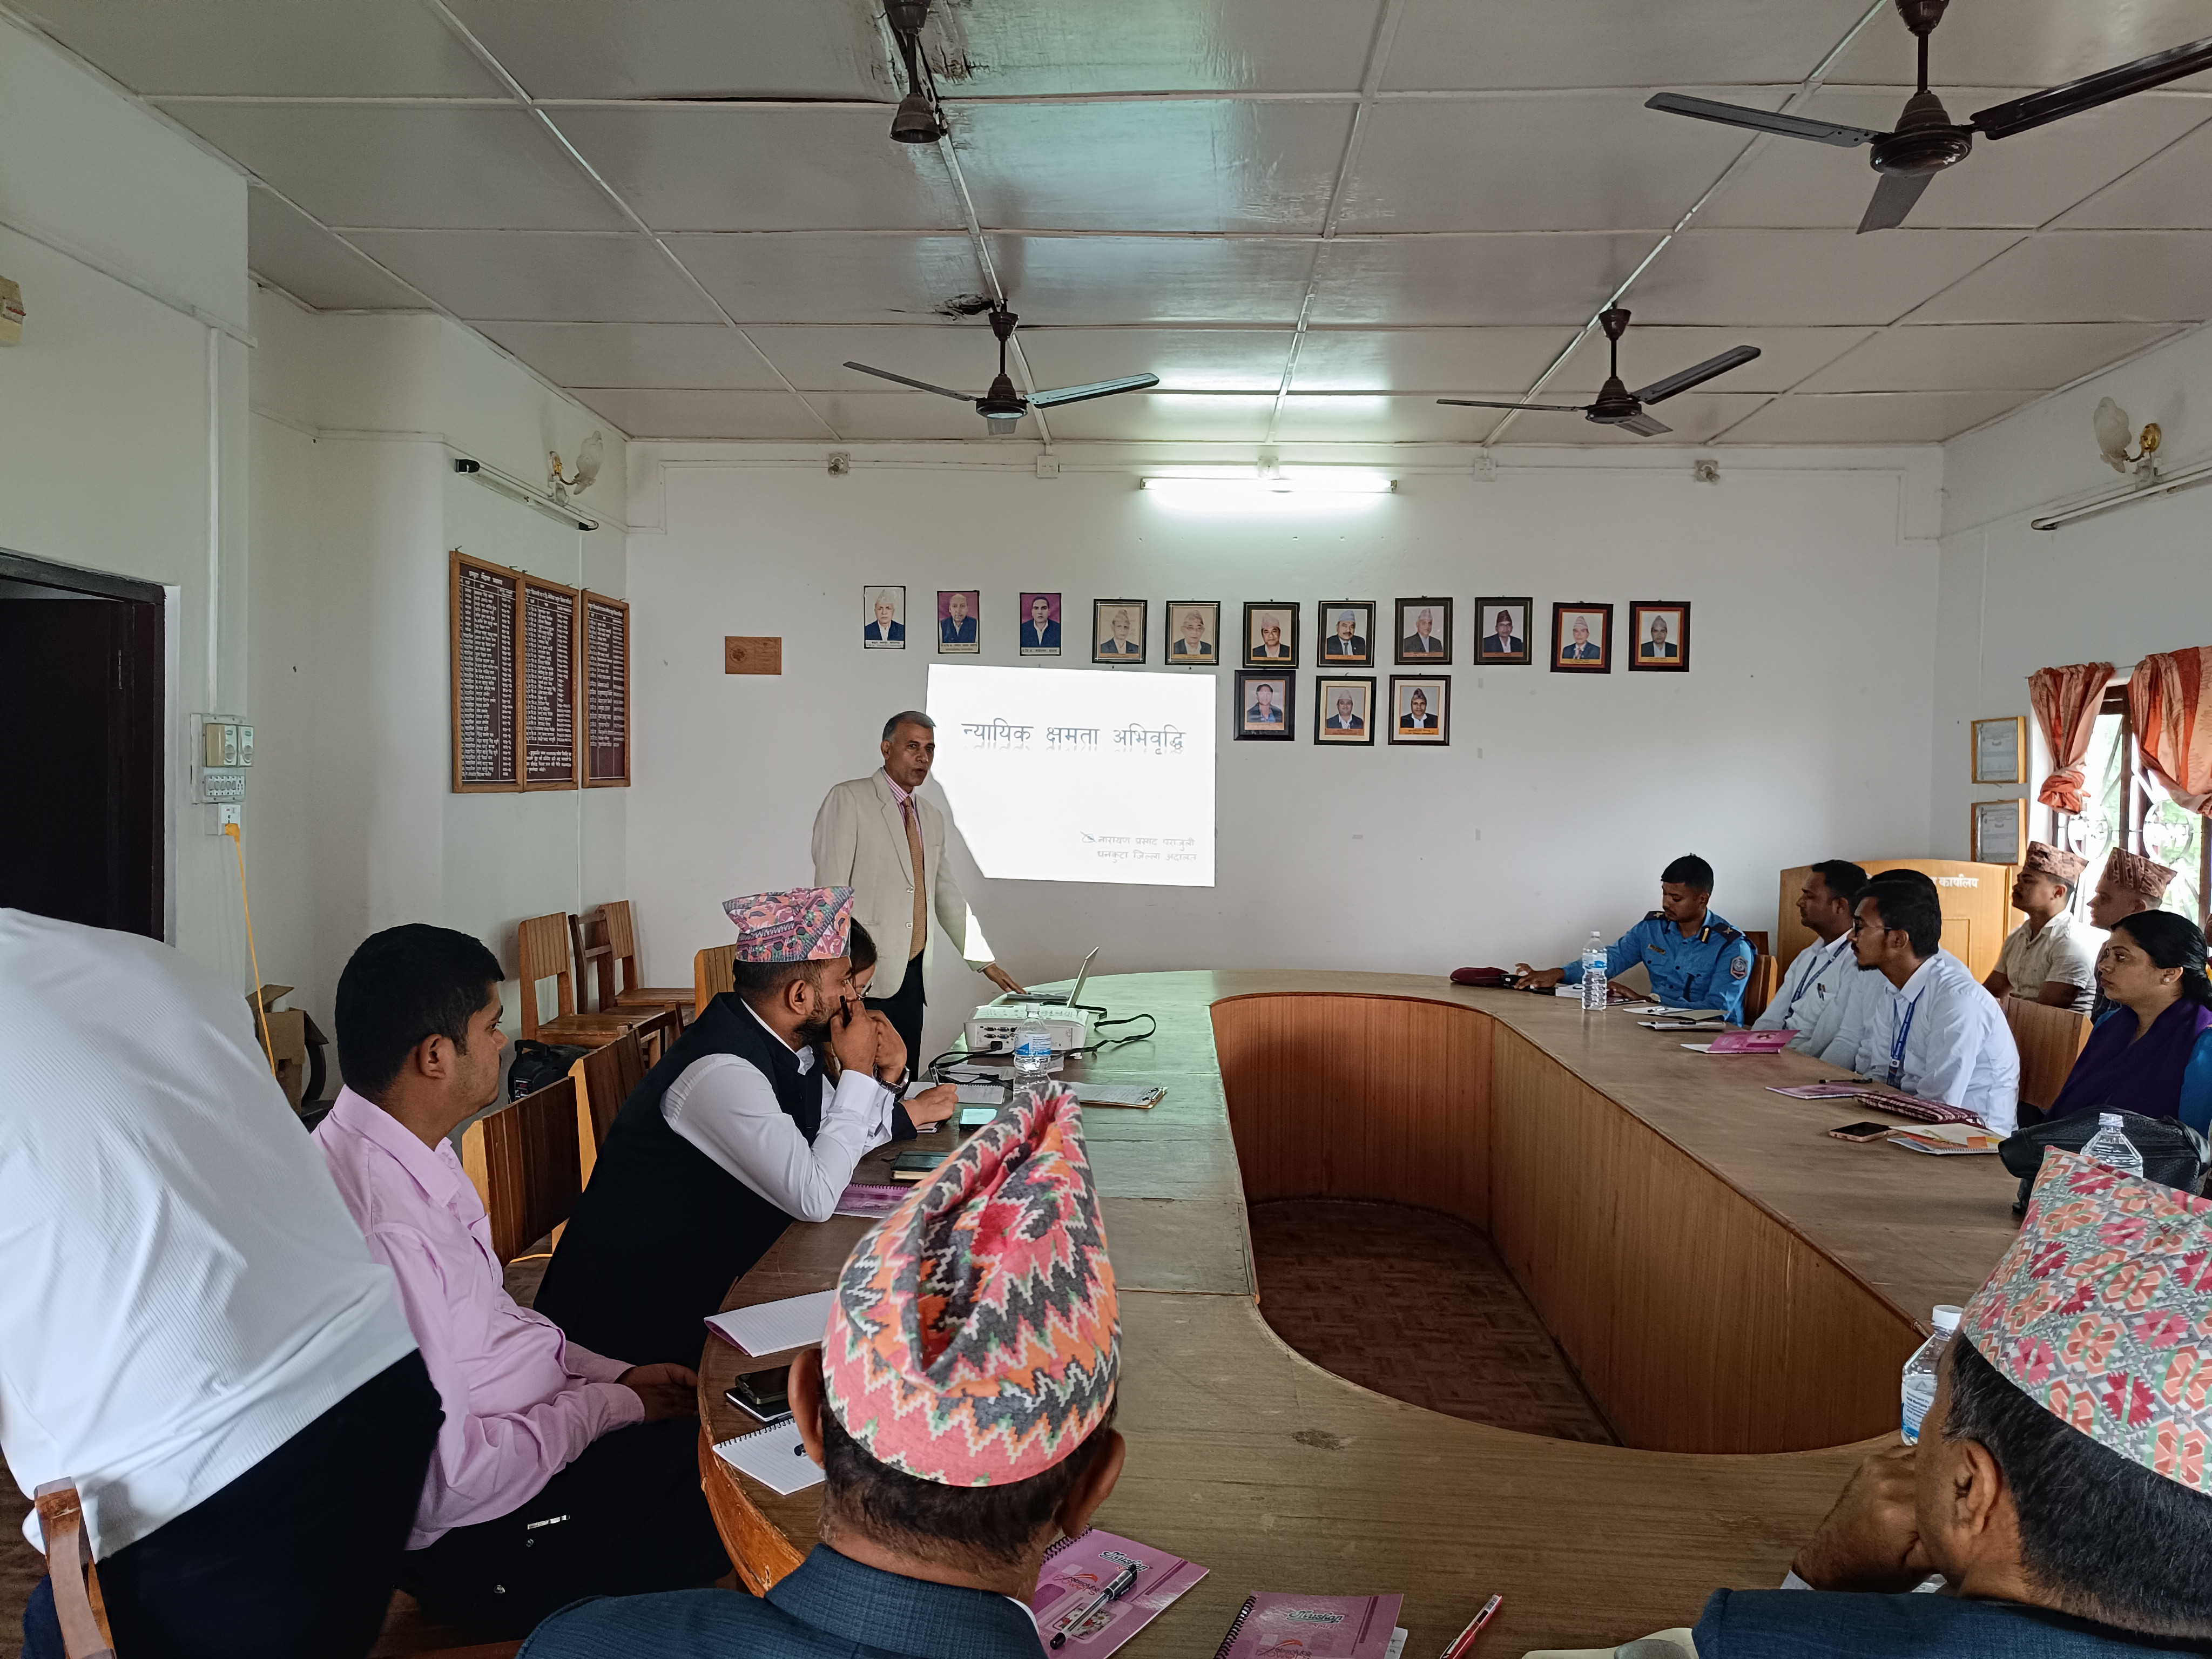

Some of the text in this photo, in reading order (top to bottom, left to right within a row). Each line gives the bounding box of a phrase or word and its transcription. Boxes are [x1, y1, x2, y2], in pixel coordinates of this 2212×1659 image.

[961, 717, 1187, 755] न्यायिक क्षमता अभिवृद्धि
[1098, 835, 1131, 845] नारायण
[1097, 849, 1197, 864] धनकुटा जिल्ला अदालत
